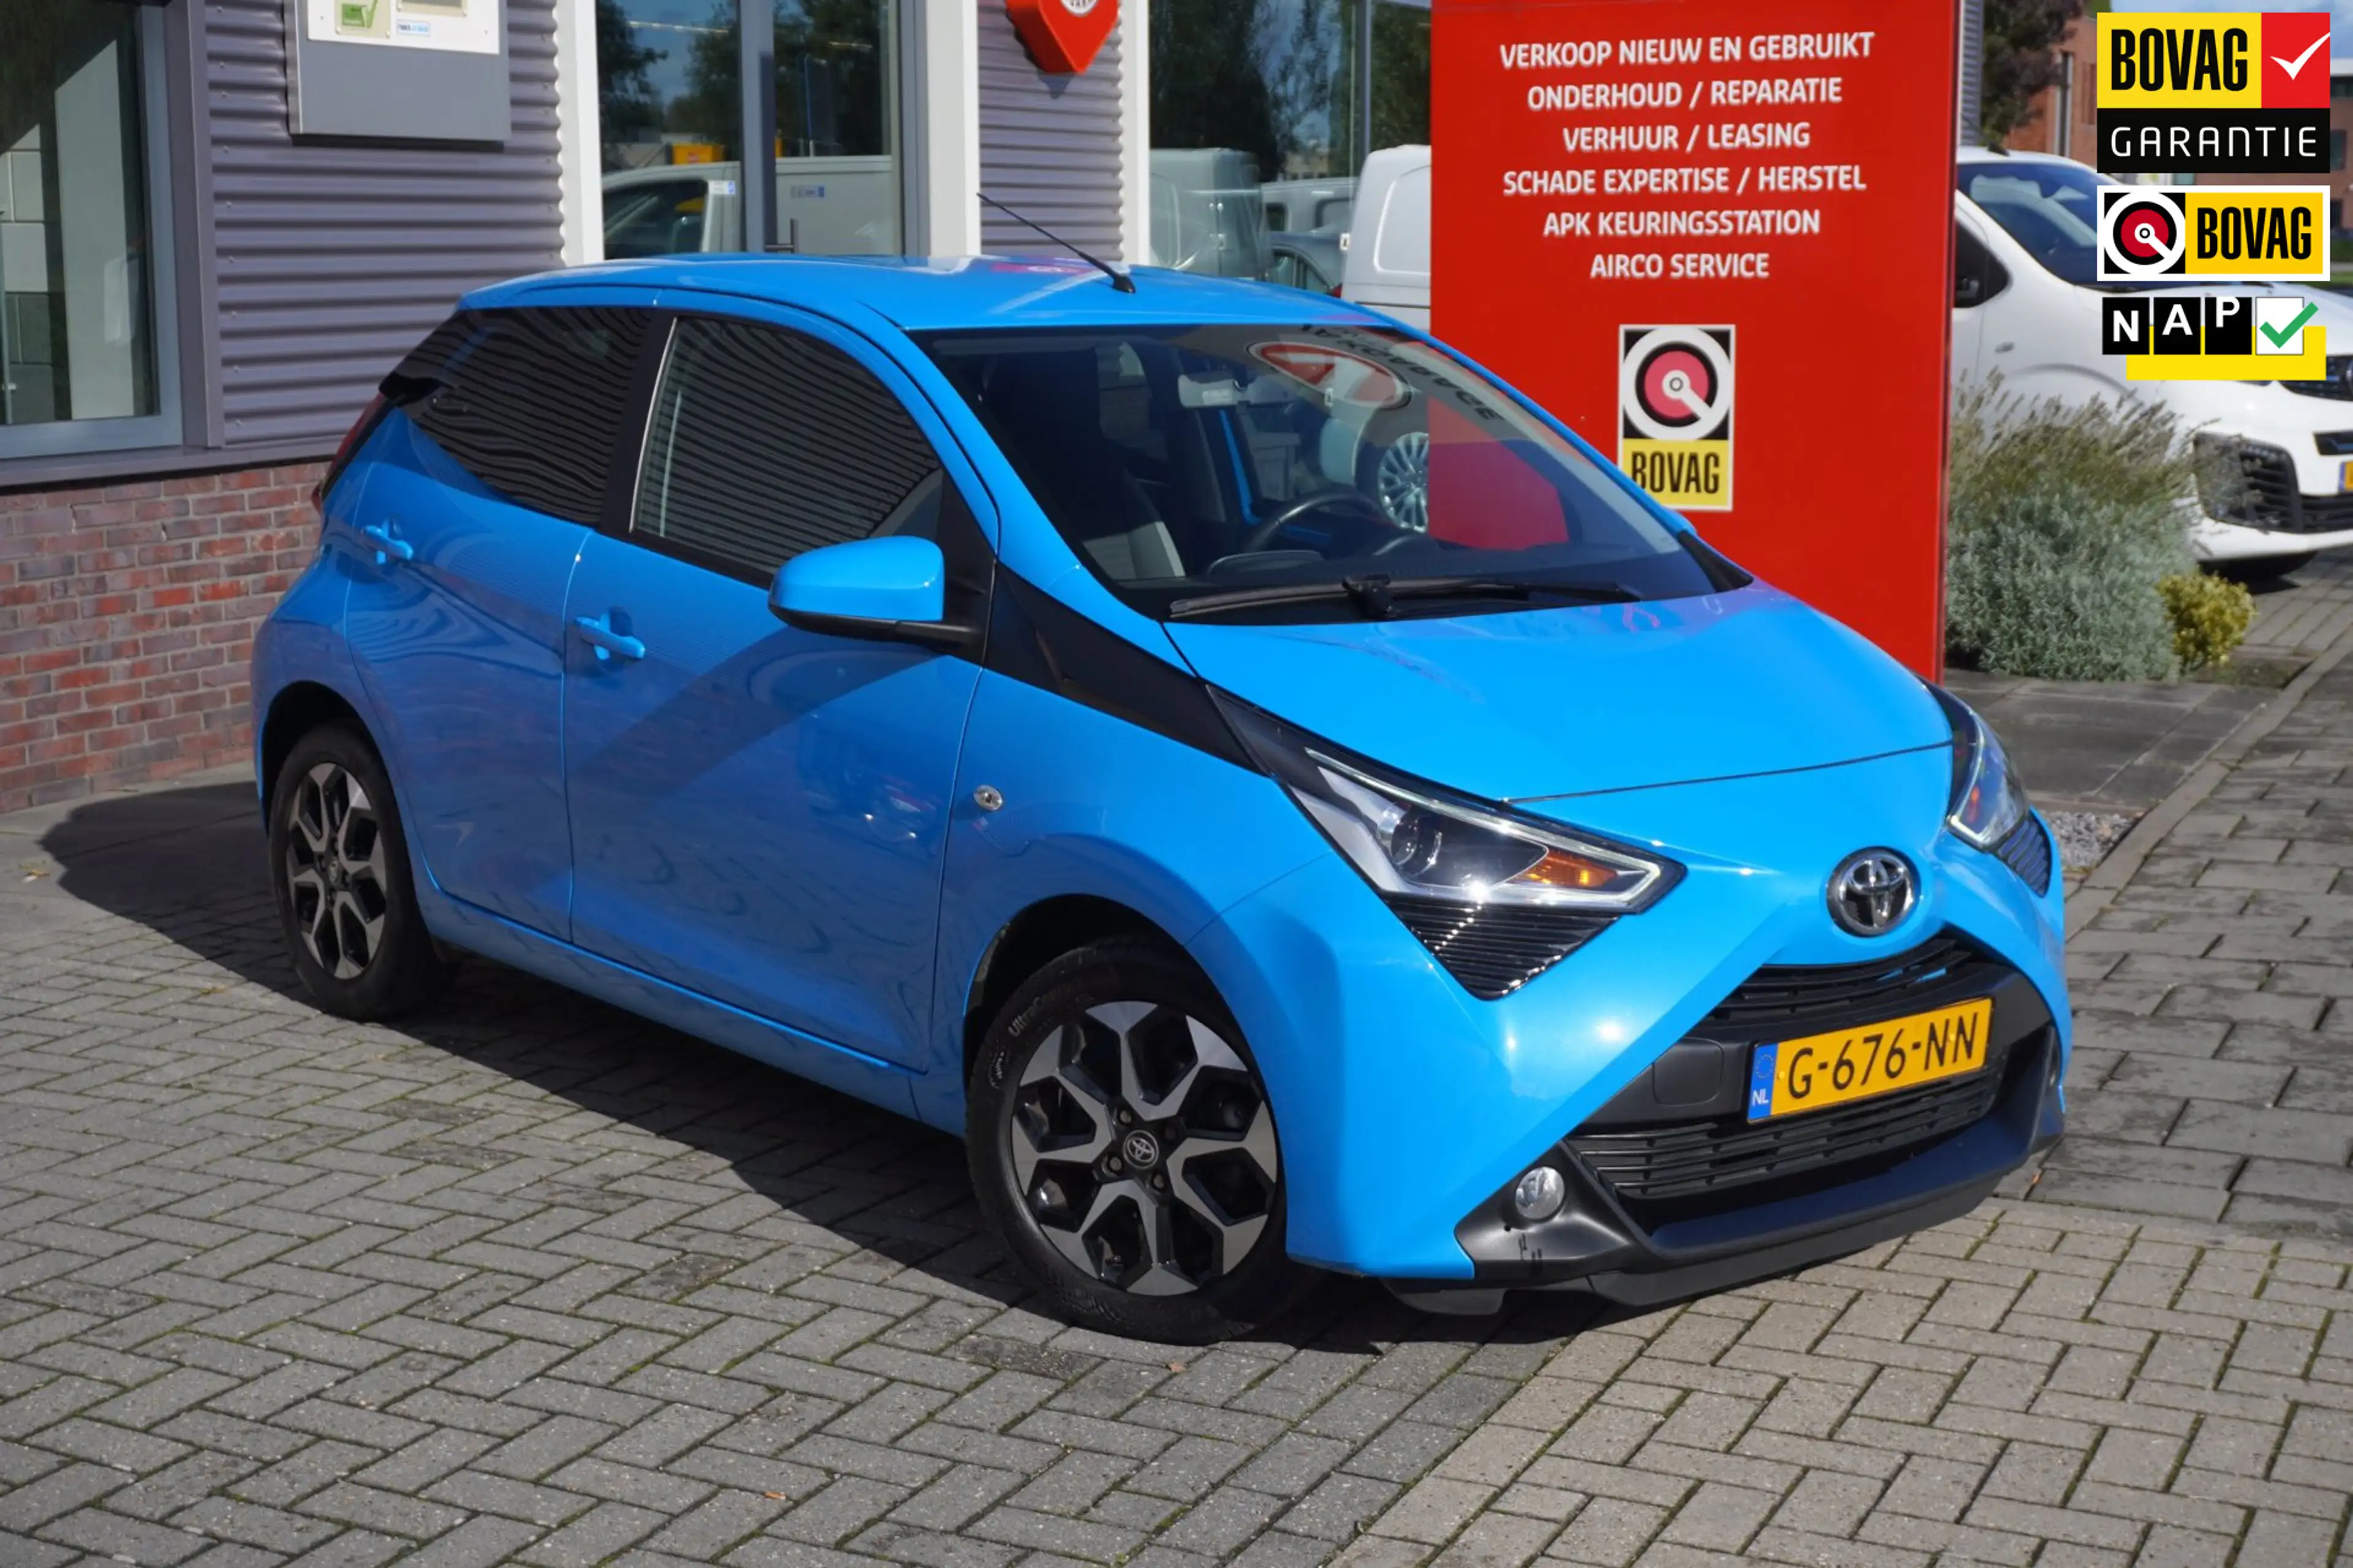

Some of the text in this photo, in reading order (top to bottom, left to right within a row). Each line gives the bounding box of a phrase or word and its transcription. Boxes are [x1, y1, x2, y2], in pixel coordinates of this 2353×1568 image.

[1500, 32, 1875, 69] VERKOOP NIEUW EN GEBRUIKT
[1528, 77, 1842, 110] ONDERHOUD / REPARATIE
[1563, 122, 1810, 153] VERHUUR / LEASING
[1504, 165, 1866, 195] SCHADE EXPERTISE / HERSTEL
[1544, 210, 1820, 236] APK KEURINGSSTATION
[1591, 253, 1769, 278] AIRCO SERVICE
[1631, 452, 1719, 494] BOVAG
[1788, 1012, 1978, 1099] G-676-NN
[1752, 1088, 1769, 1105] NL
